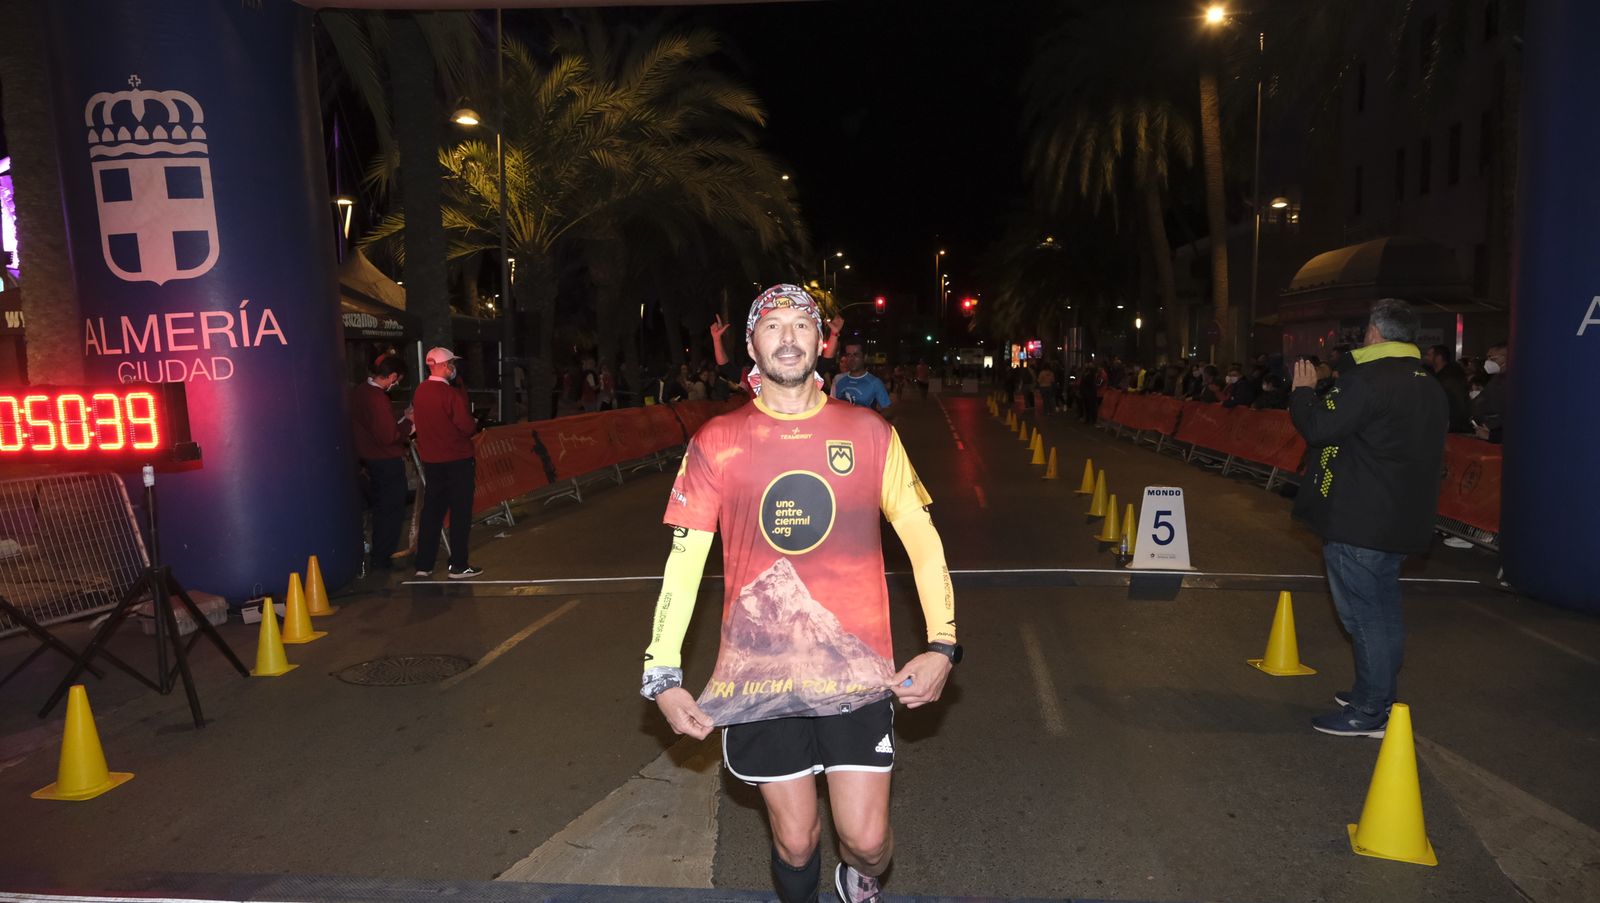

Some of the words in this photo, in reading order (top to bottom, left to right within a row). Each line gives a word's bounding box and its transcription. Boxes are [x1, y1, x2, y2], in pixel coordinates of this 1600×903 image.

[85, 300, 288, 356] ALMERÍA
[117, 357, 234, 384] CIUDAD
[776, 500, 795, 508] uno
[775, 508, 803, 517] entre
[775, 515, 810, 526] cienmil
[771, 527, 792, 537] .org
[1152, 510, 1175, 546] 5
[742, 678, 793, 696] LUCHA
[801, 679, 838, 695] POR
